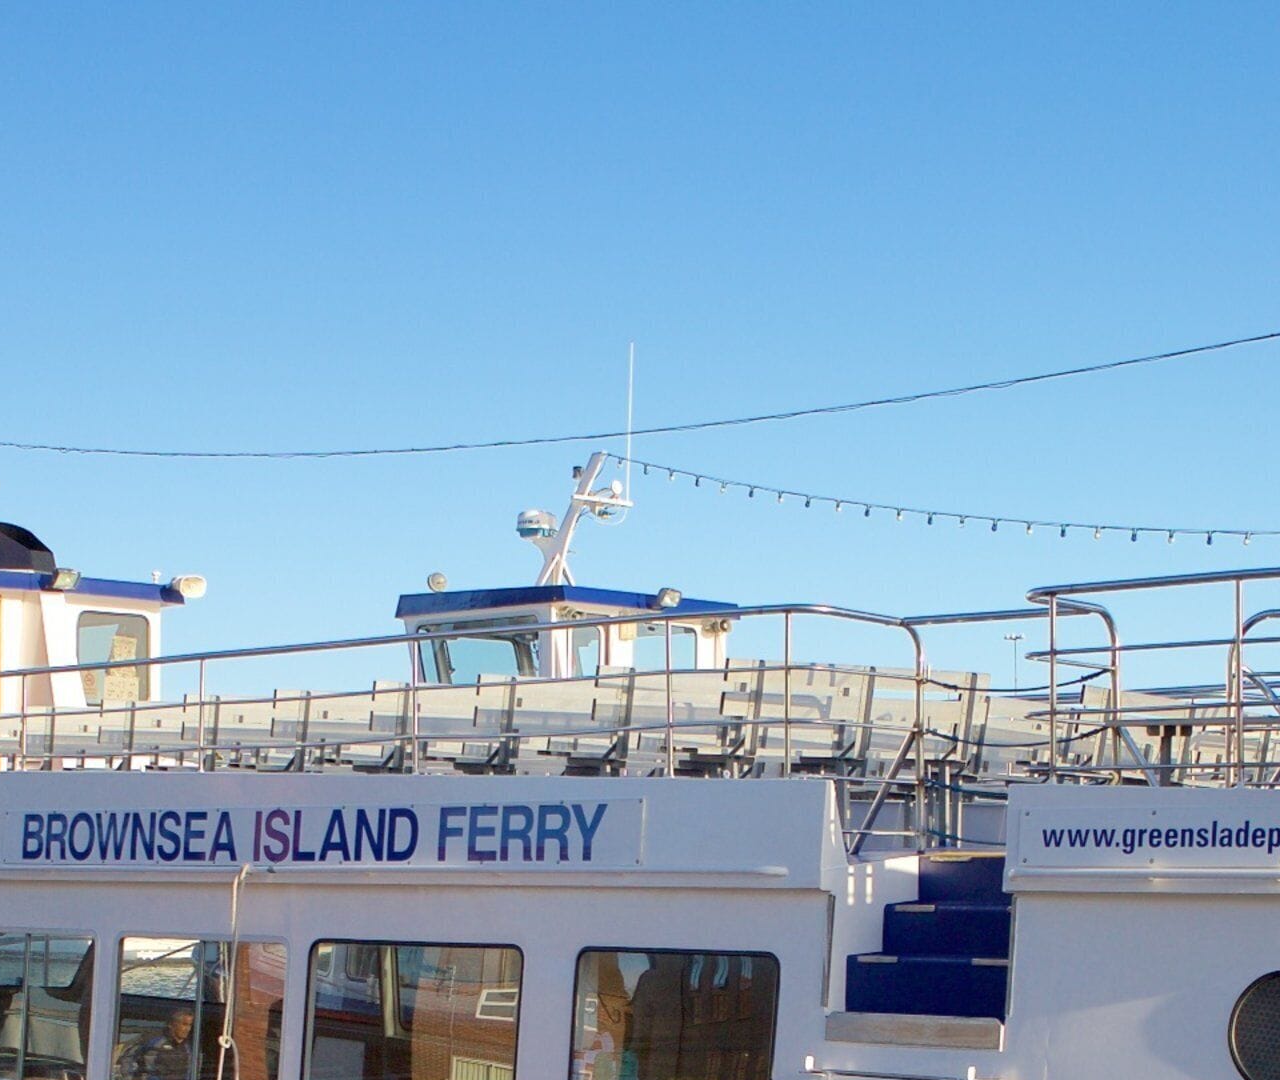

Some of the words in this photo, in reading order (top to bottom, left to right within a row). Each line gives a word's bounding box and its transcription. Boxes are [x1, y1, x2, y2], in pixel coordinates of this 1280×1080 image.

[21, 810, 238, 863] BROWNSEA
[252, 808, 419, 863] ISLAND
[436, 803, 609, 862] FERRY
